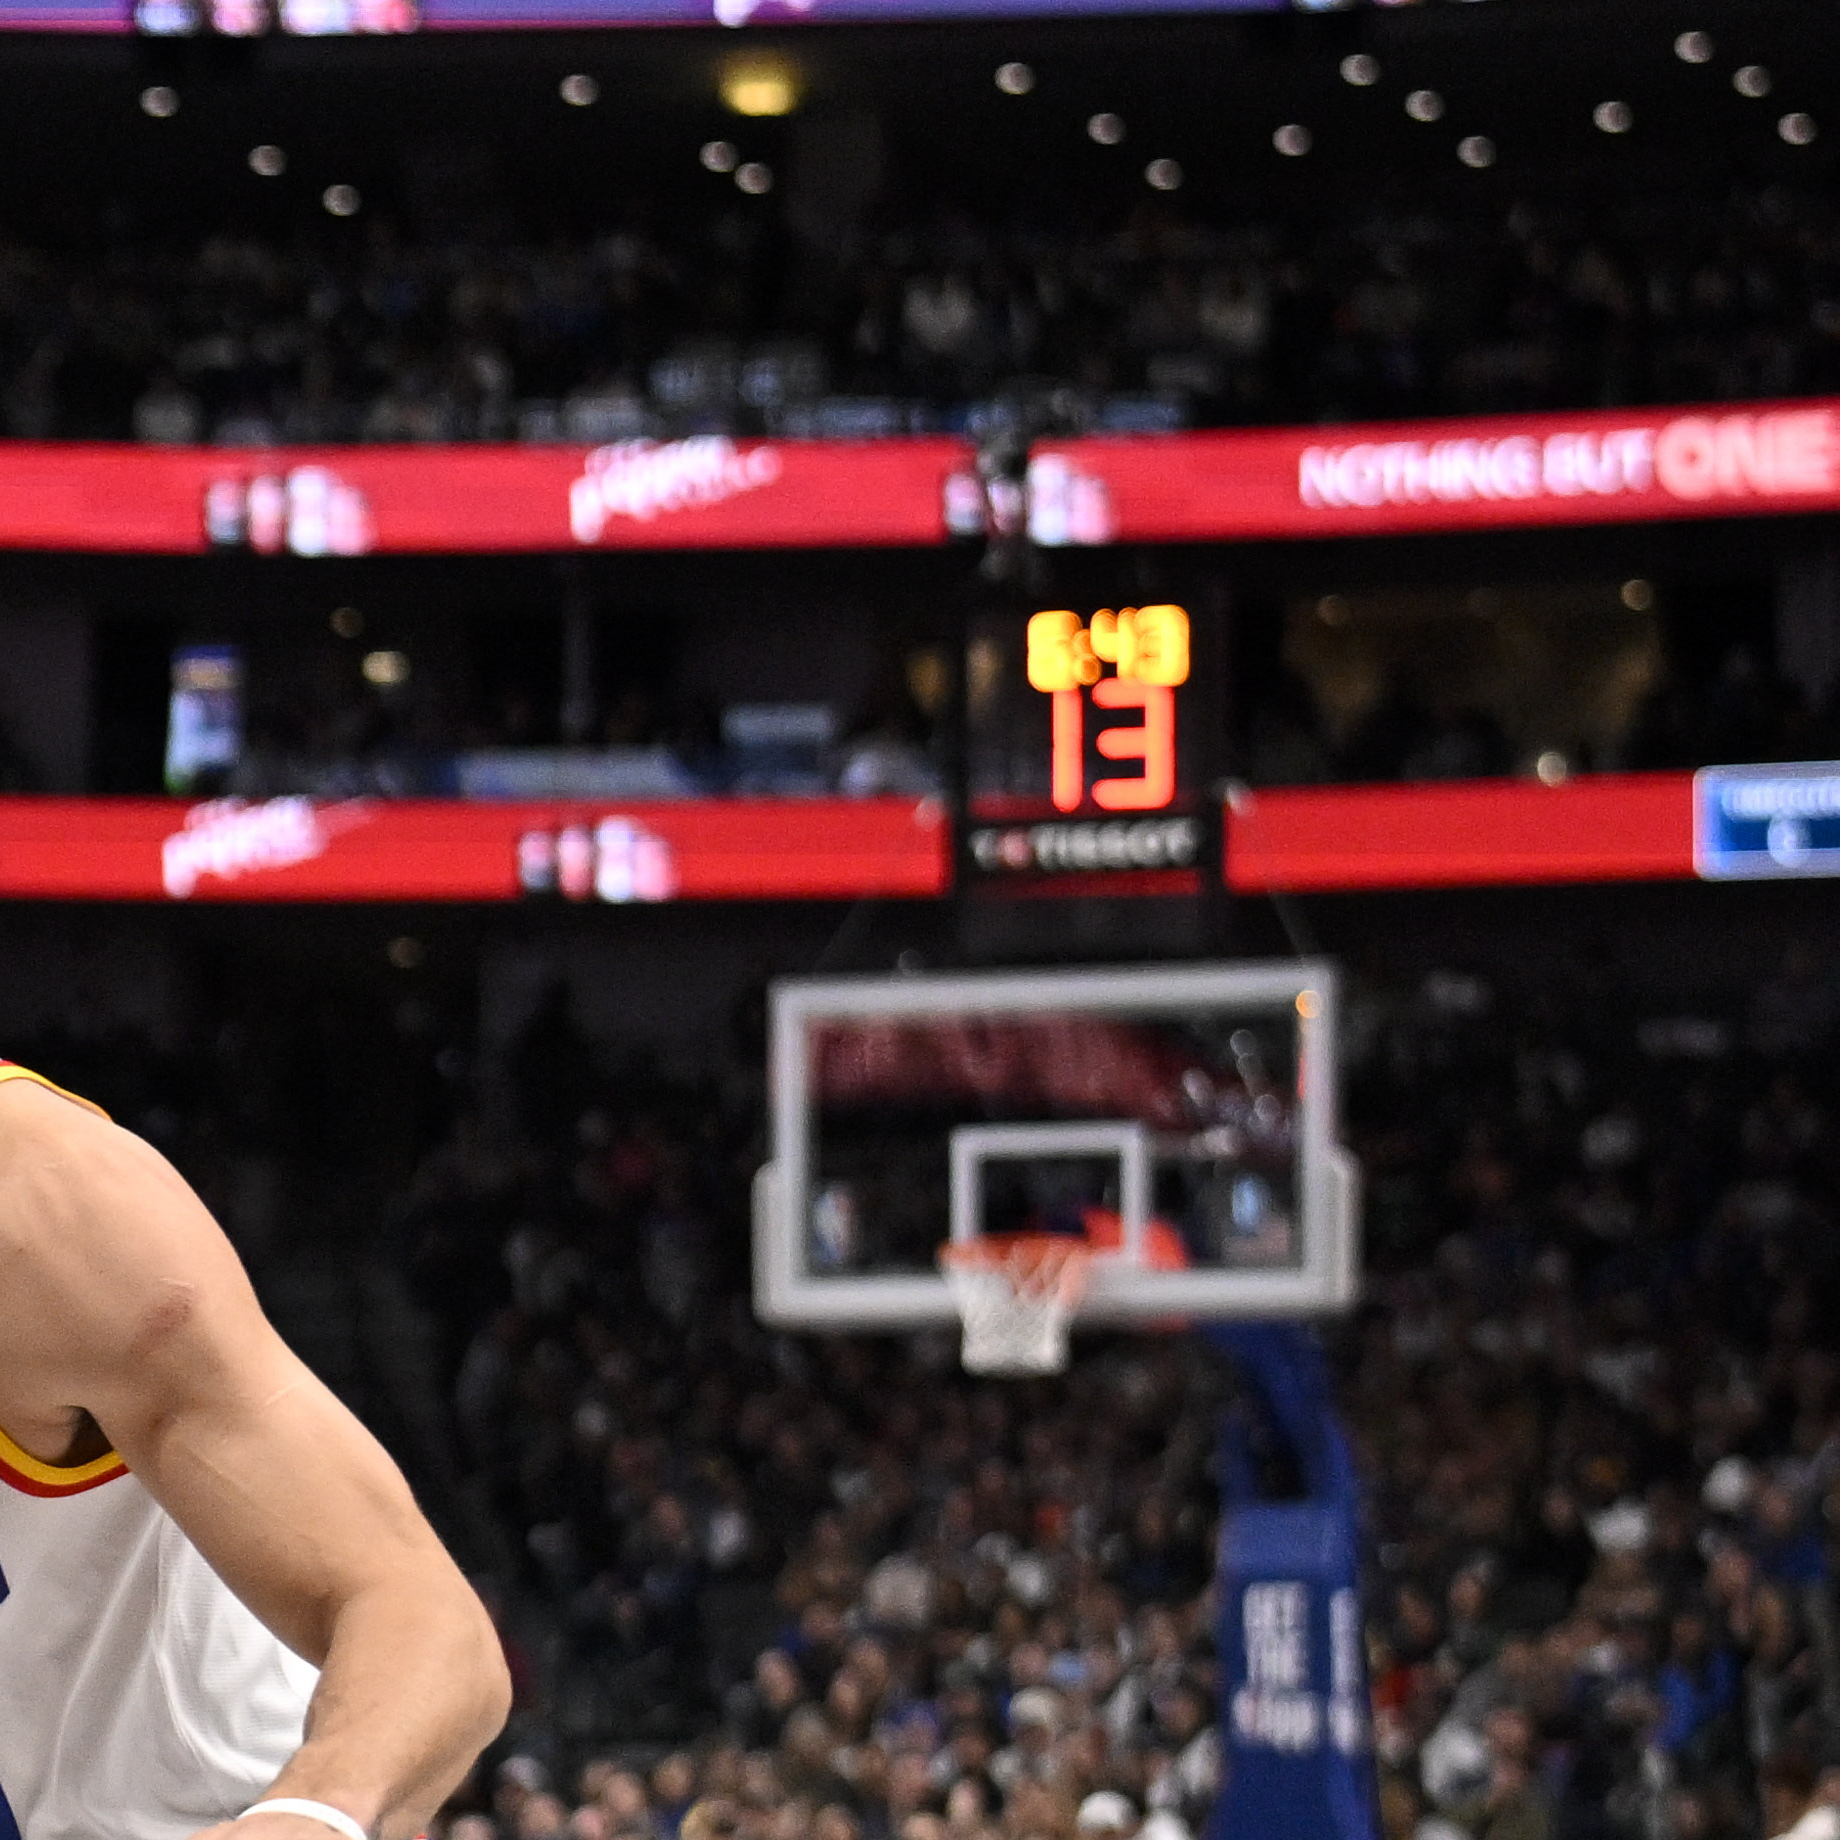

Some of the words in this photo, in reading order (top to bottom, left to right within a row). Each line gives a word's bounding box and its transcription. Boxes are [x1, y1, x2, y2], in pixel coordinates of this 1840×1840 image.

[1299, 434, 1541, 509] NOTHING
[1543, 428, 1655, 497] BUT
[1052, 676, 1176, 813] 13
